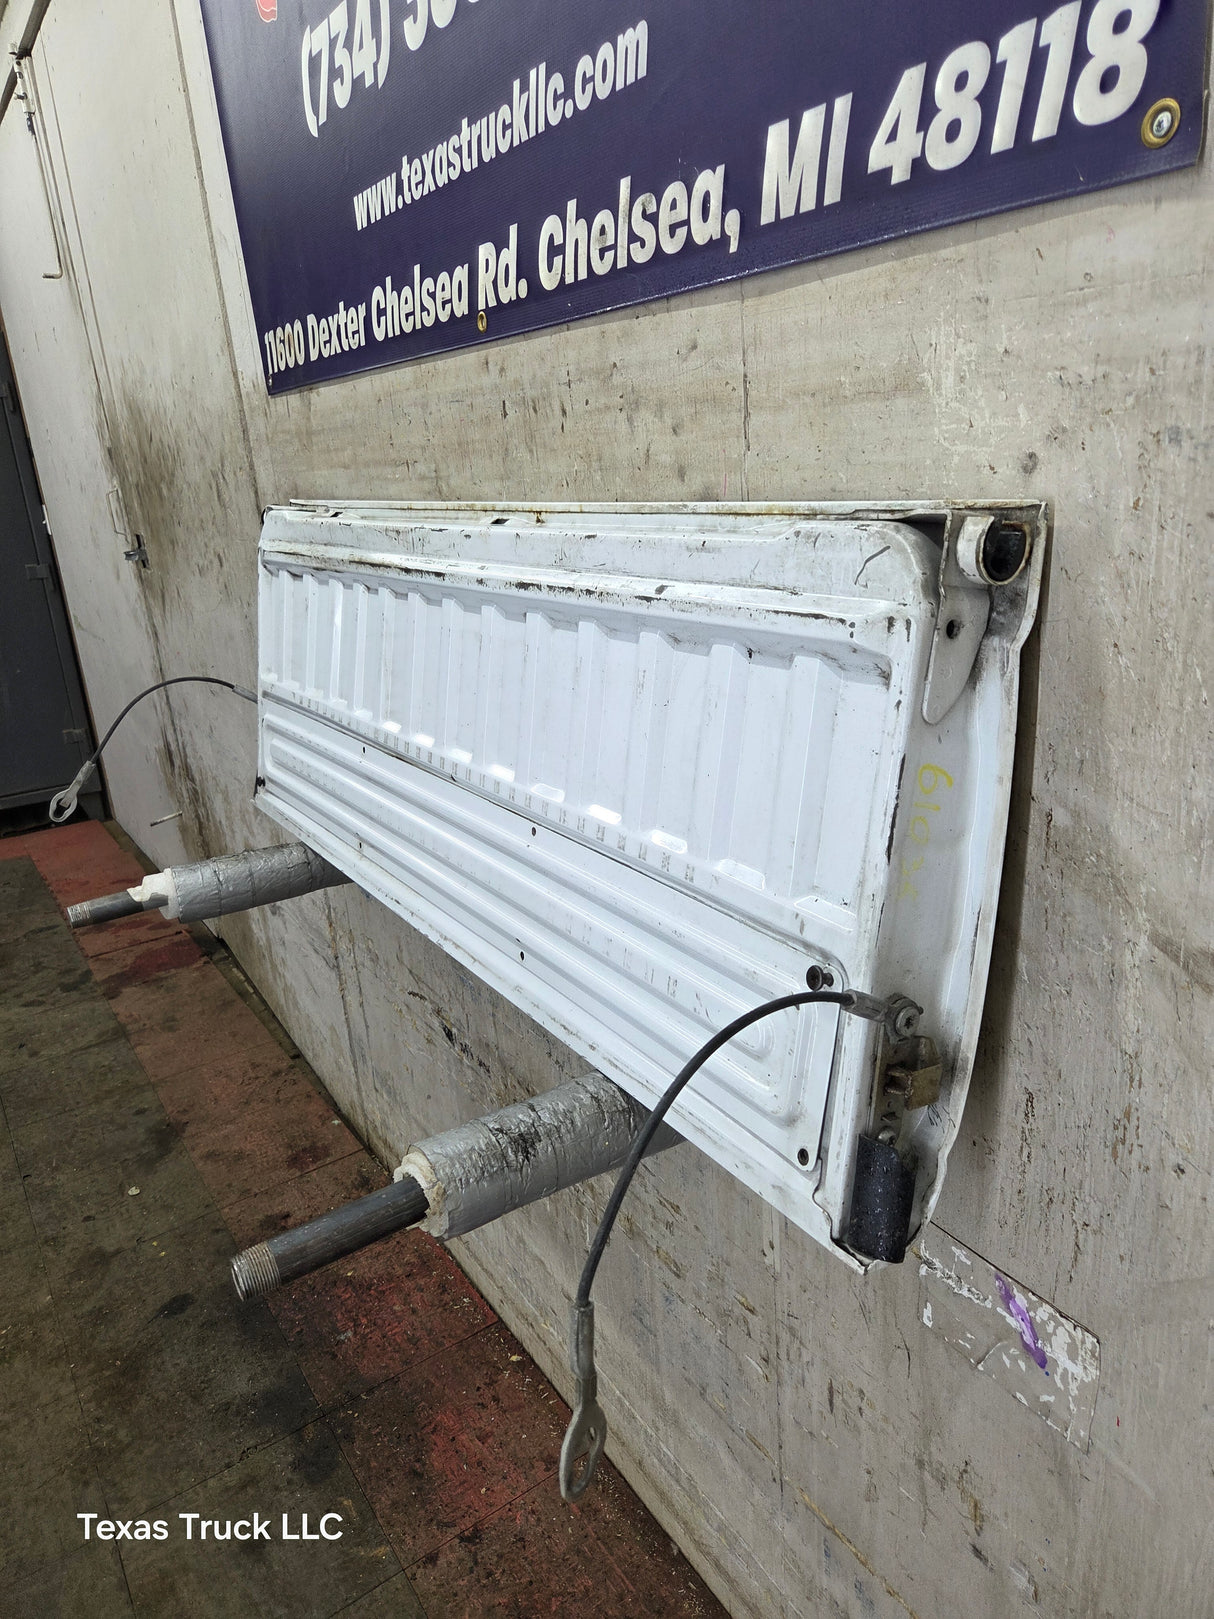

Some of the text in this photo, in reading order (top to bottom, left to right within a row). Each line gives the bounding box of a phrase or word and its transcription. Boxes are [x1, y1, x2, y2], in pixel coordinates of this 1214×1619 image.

[302, 0, 390, 137] (734)
[353, 19, 649, 231] www.texastruckllc.com
[264, 0, 1160, 374] 11600 Dexter Chelsea Rd. Chelsea, MI 48118
